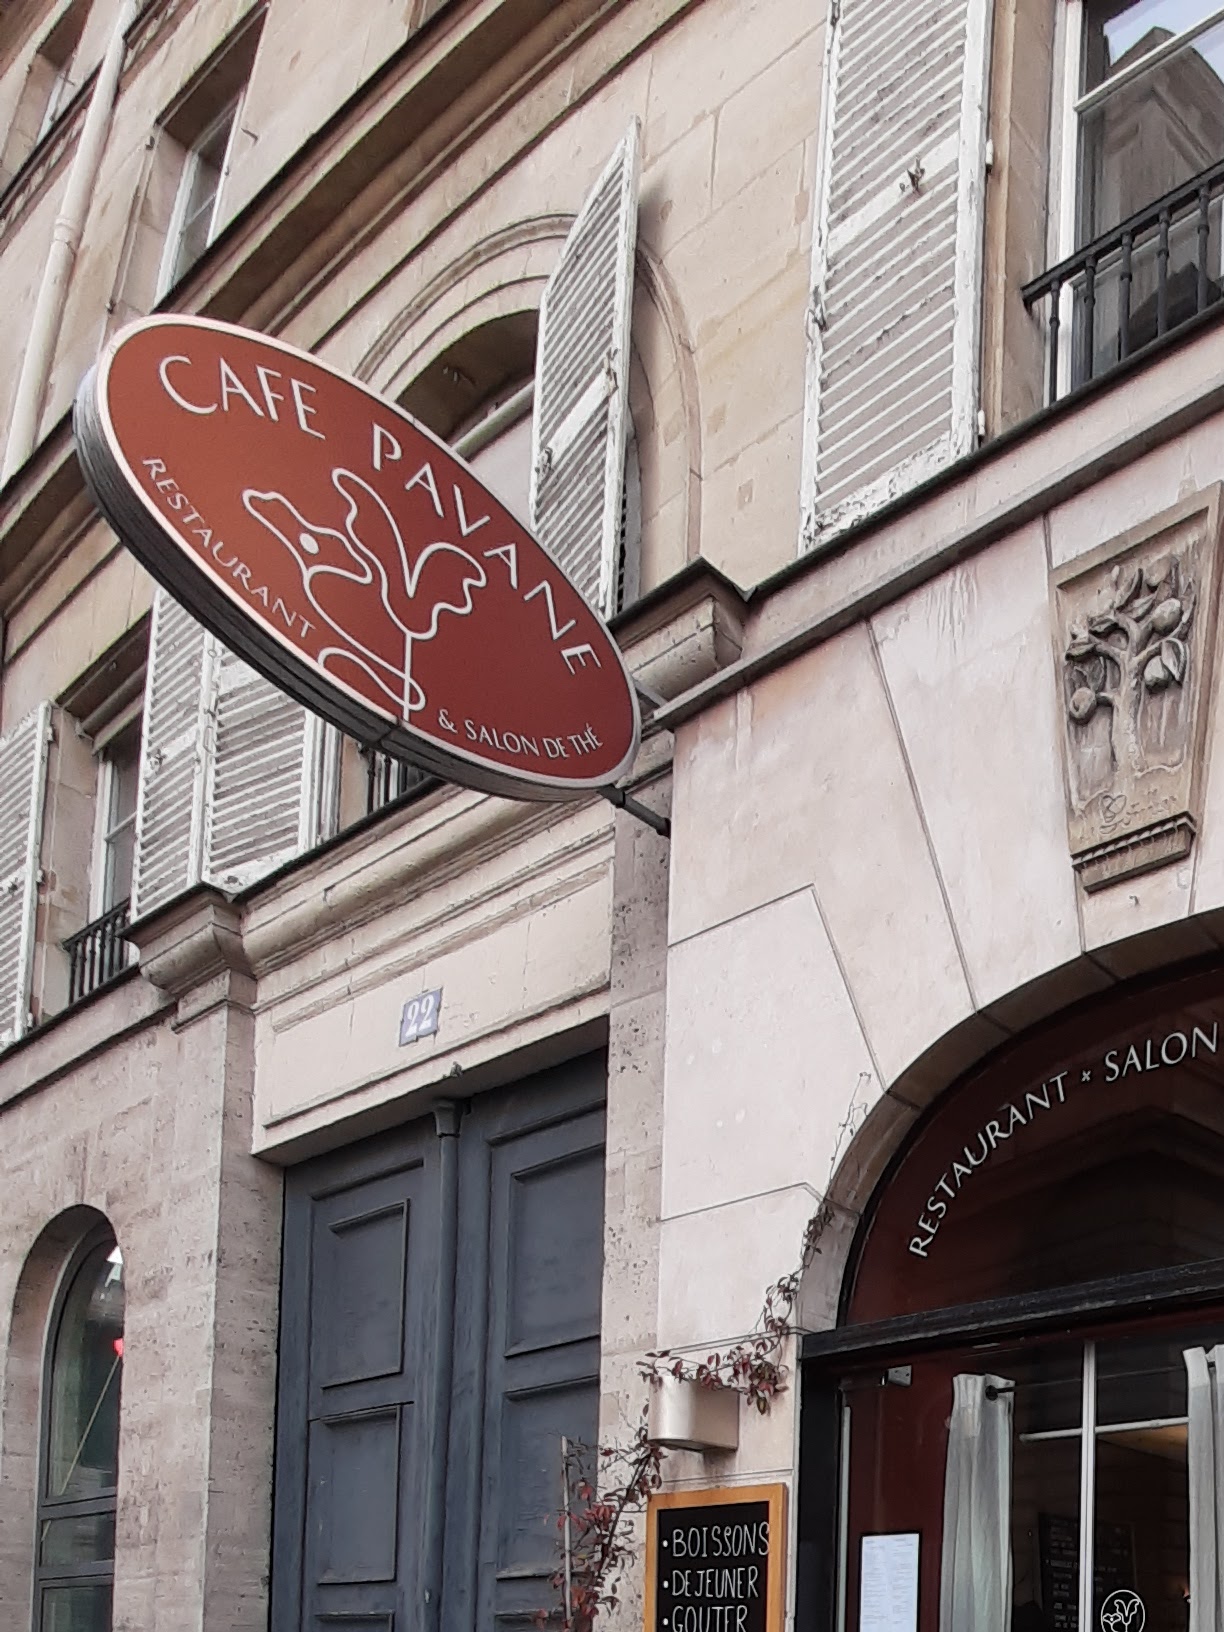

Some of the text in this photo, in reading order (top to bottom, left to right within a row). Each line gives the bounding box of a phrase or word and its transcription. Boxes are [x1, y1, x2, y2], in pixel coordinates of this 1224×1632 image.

[159, 355, 602, 676] CAFE PAVANE
[142, 457, 604, 760] RESTAURANT & SALON DE THÉ
[405, 994, 435, 1038] 22
[908, 1071, 1070, 1259] RESTAURANT
[1103, 1021, 1219, 1084] SALON
[671, 1520, 770, 1558] BOISSONS
[671, 1565, 760, 1600] DEJEUNER
